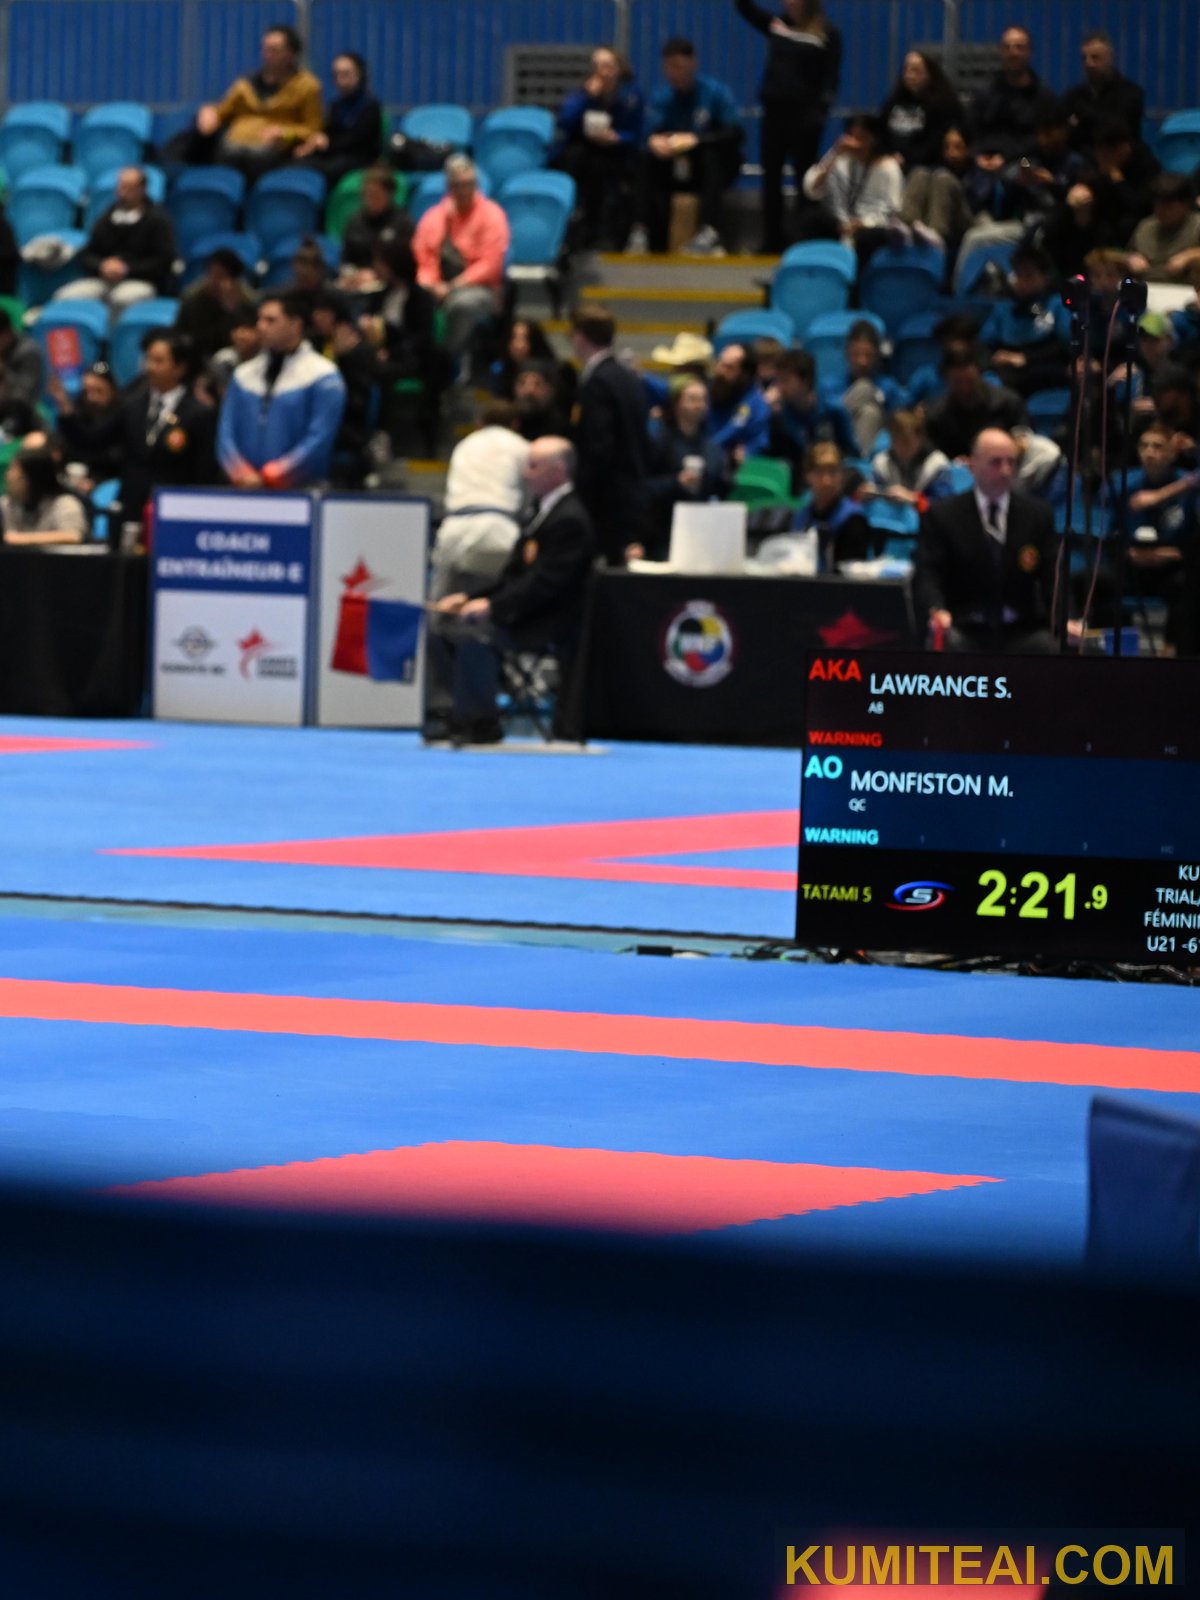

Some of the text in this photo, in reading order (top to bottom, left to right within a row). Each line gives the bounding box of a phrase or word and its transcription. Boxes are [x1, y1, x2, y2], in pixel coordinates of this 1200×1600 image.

[808, 658, 862, 681] AKA
[870, 673, 1012, 699] LAWRANCE S.
[867, 701, 884, 715] AB
[808, 730, 883, 747] WARNING
[804, 754, 843, 779] AO
[850, 769, 1014, 798] MONFISTON M.
[848, 797, 867, 812] QC
[804, 826, 879, 845] WARNING
[801, 883, 859, 902] TATAMI
[1155, 887, 1200, 906] TRIAL
[1143, 907, 1200, 929] FÉMINI
[1146, 935, 1200, 954] U21 -6
